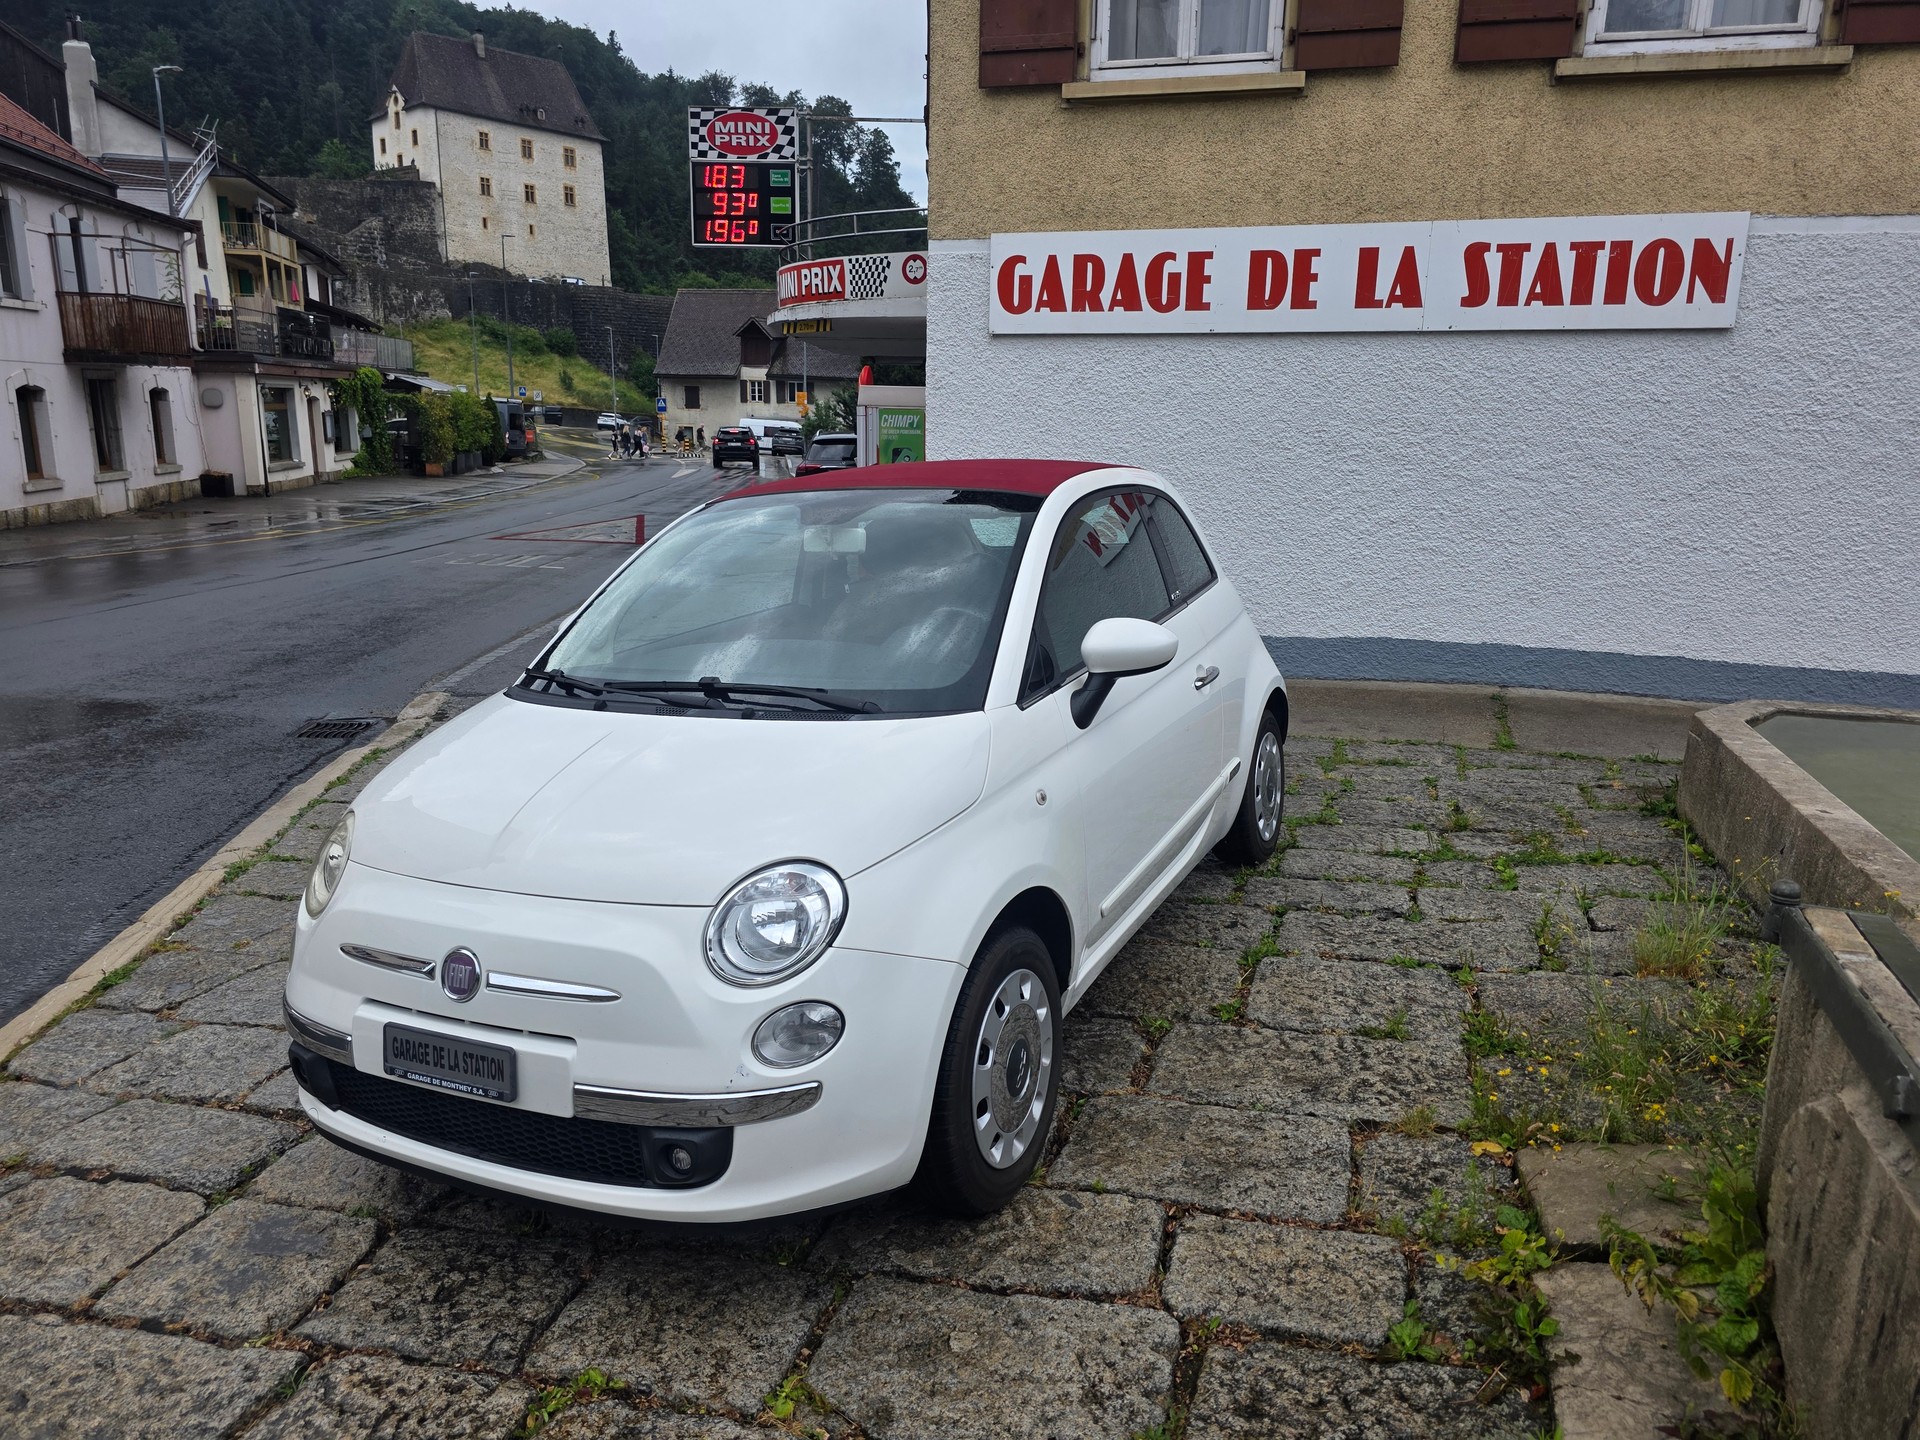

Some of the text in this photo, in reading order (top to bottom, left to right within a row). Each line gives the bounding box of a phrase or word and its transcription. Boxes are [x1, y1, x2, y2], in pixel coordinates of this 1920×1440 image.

[714, 121, 770, 134] MINI
[714, 134, 772, 147] PRIX
[779, 264, 843, 301] MINI PRIX
[998, 239, 1733, 314] GARAGE DE LA STATION
[881, 414, 920, 428] CHIMPY
[448, 963, 472, 989] FIAT
[392, 1036, 505, 1083] GARAGE DE LA STATION
[407, 1072, 485, 1096] GARAGE DE MONTHEY S.A.
